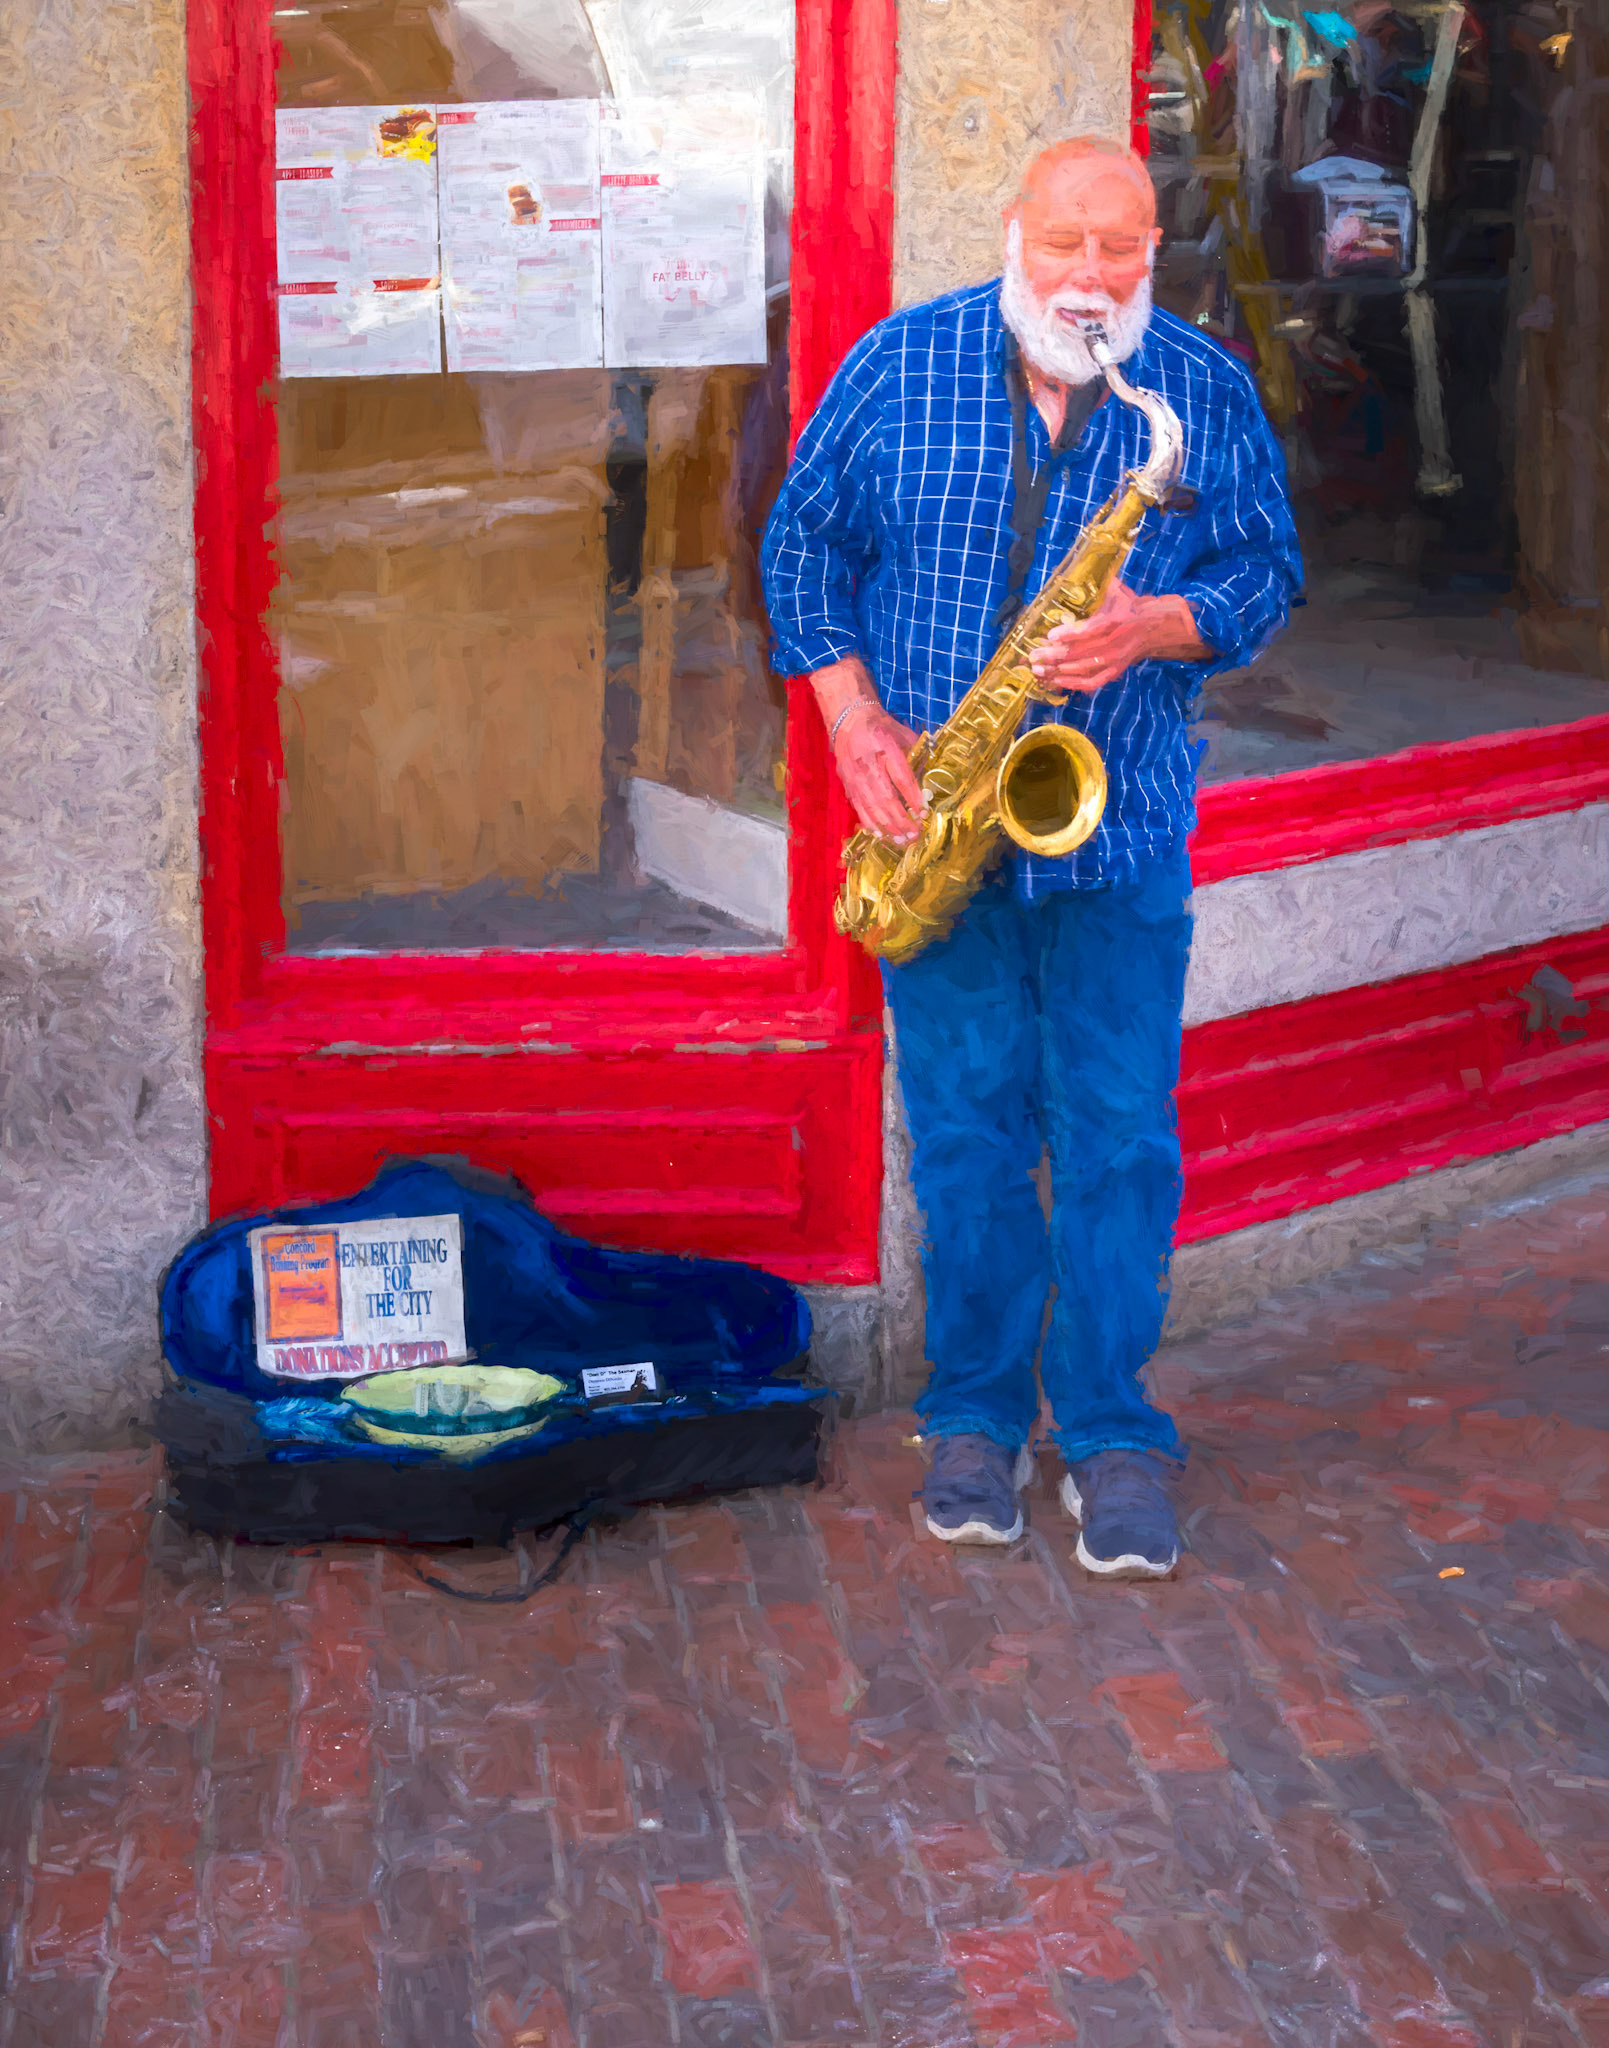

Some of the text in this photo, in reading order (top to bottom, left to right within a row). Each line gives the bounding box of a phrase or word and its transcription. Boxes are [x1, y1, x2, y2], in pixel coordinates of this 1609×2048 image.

[652, 272, 671, 282] FAT
[341, 1238, 448, 1268] ENTERTAINING
[383, 1266, 413, 1292] FOR
[366, 1290, 433, 1319] THE CITY
[274, 1344, 365, 1375] DONATIONS
